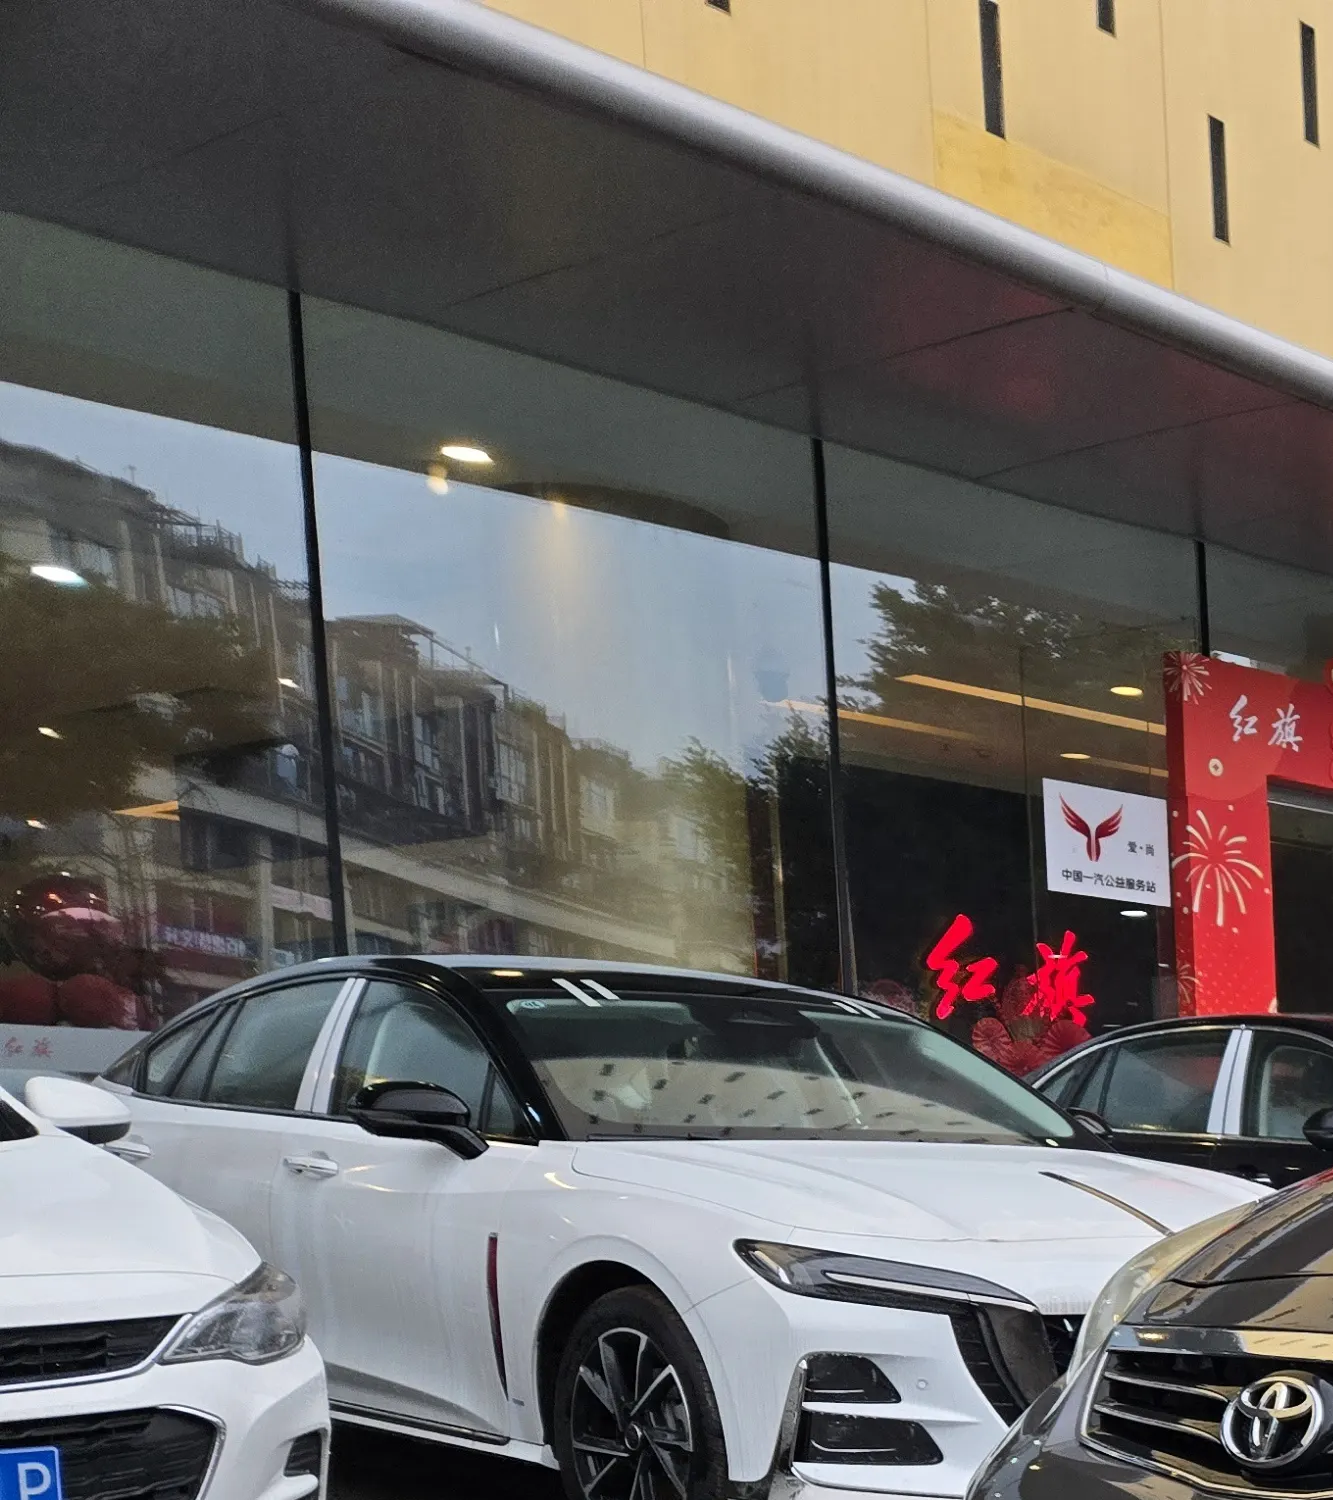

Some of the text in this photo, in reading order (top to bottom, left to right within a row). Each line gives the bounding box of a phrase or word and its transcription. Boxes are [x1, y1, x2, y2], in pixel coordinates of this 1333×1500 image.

[1229, 694, 1303, 752] 红旗
[1061, 868, 1156, 894] 中国一汽公益服务站
[926, 913, 1095, 1027] 红旗
